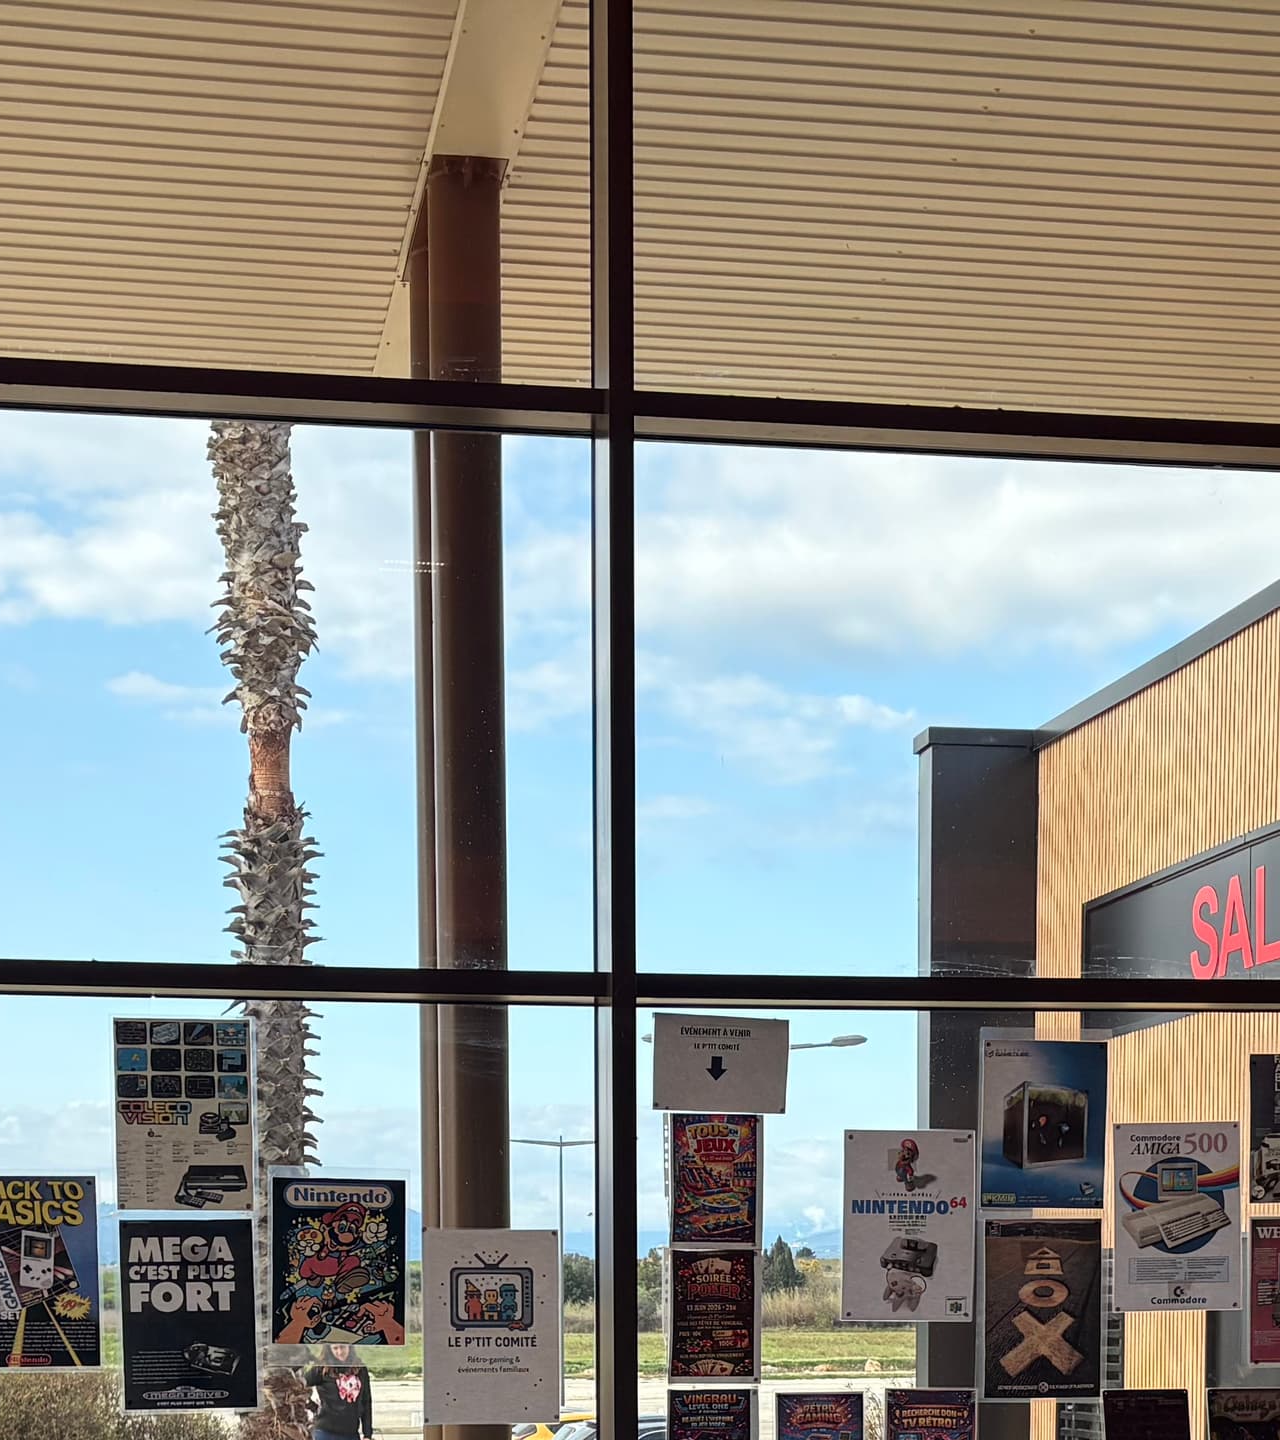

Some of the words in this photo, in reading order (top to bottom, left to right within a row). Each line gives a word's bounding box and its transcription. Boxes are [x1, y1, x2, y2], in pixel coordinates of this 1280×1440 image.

[730, 1028, 751, 1038] VENIR
[117, 1100, 192, 1114] COLECO
[122, 1112, 189, 1125] VISION
[688, 1124, 729, 1139] TOUS
[1130, 1134, 1181, 1142] Commodore
[694, 1139, 736, 1154] JEUX
[1131, 1142, 1181, 1156] AMIGA
[1184, 1132, 1228, 1156] 500
[47, 1181, 84, 1201] TO
[294, 1187, 387, 1203] Nintendo
[851, 1200, 949, 1215] NINTENDO
[950, 1197, 967, 1209] 64
[128, 1236, 234, 1263] MEGA
[129, 1266, 180, 1281] C'EST
[187, 1265, 235, 1280] PLUS
[696, 1273, 732, 1283] SOIRÉE
[129, 1281, 236, 1313] FORT
[1150, 1296, 1207, 1305] Commodore
[0, 1311, 21, 1320] SET
[448, 1337, 461, 1348] LE
[465, 1337, 492, 1348] P'TIT
[495, 1334, 537, 1348] COMITÉ
[467, 1355, 513, 1366] Rétro-gaming
[457, 1365, 499, 1374] événements
[499, 1365, 530, 1373] familiaux
[150, 1391, 184, 1400] MEGA
[187, 1390, 223, 1399] DRIVE
[683, 1394, 736, 1404] VINGRAU
[797, 1413, 842, 1423] GAMING
[902, 1418, 917, 1428] TV
